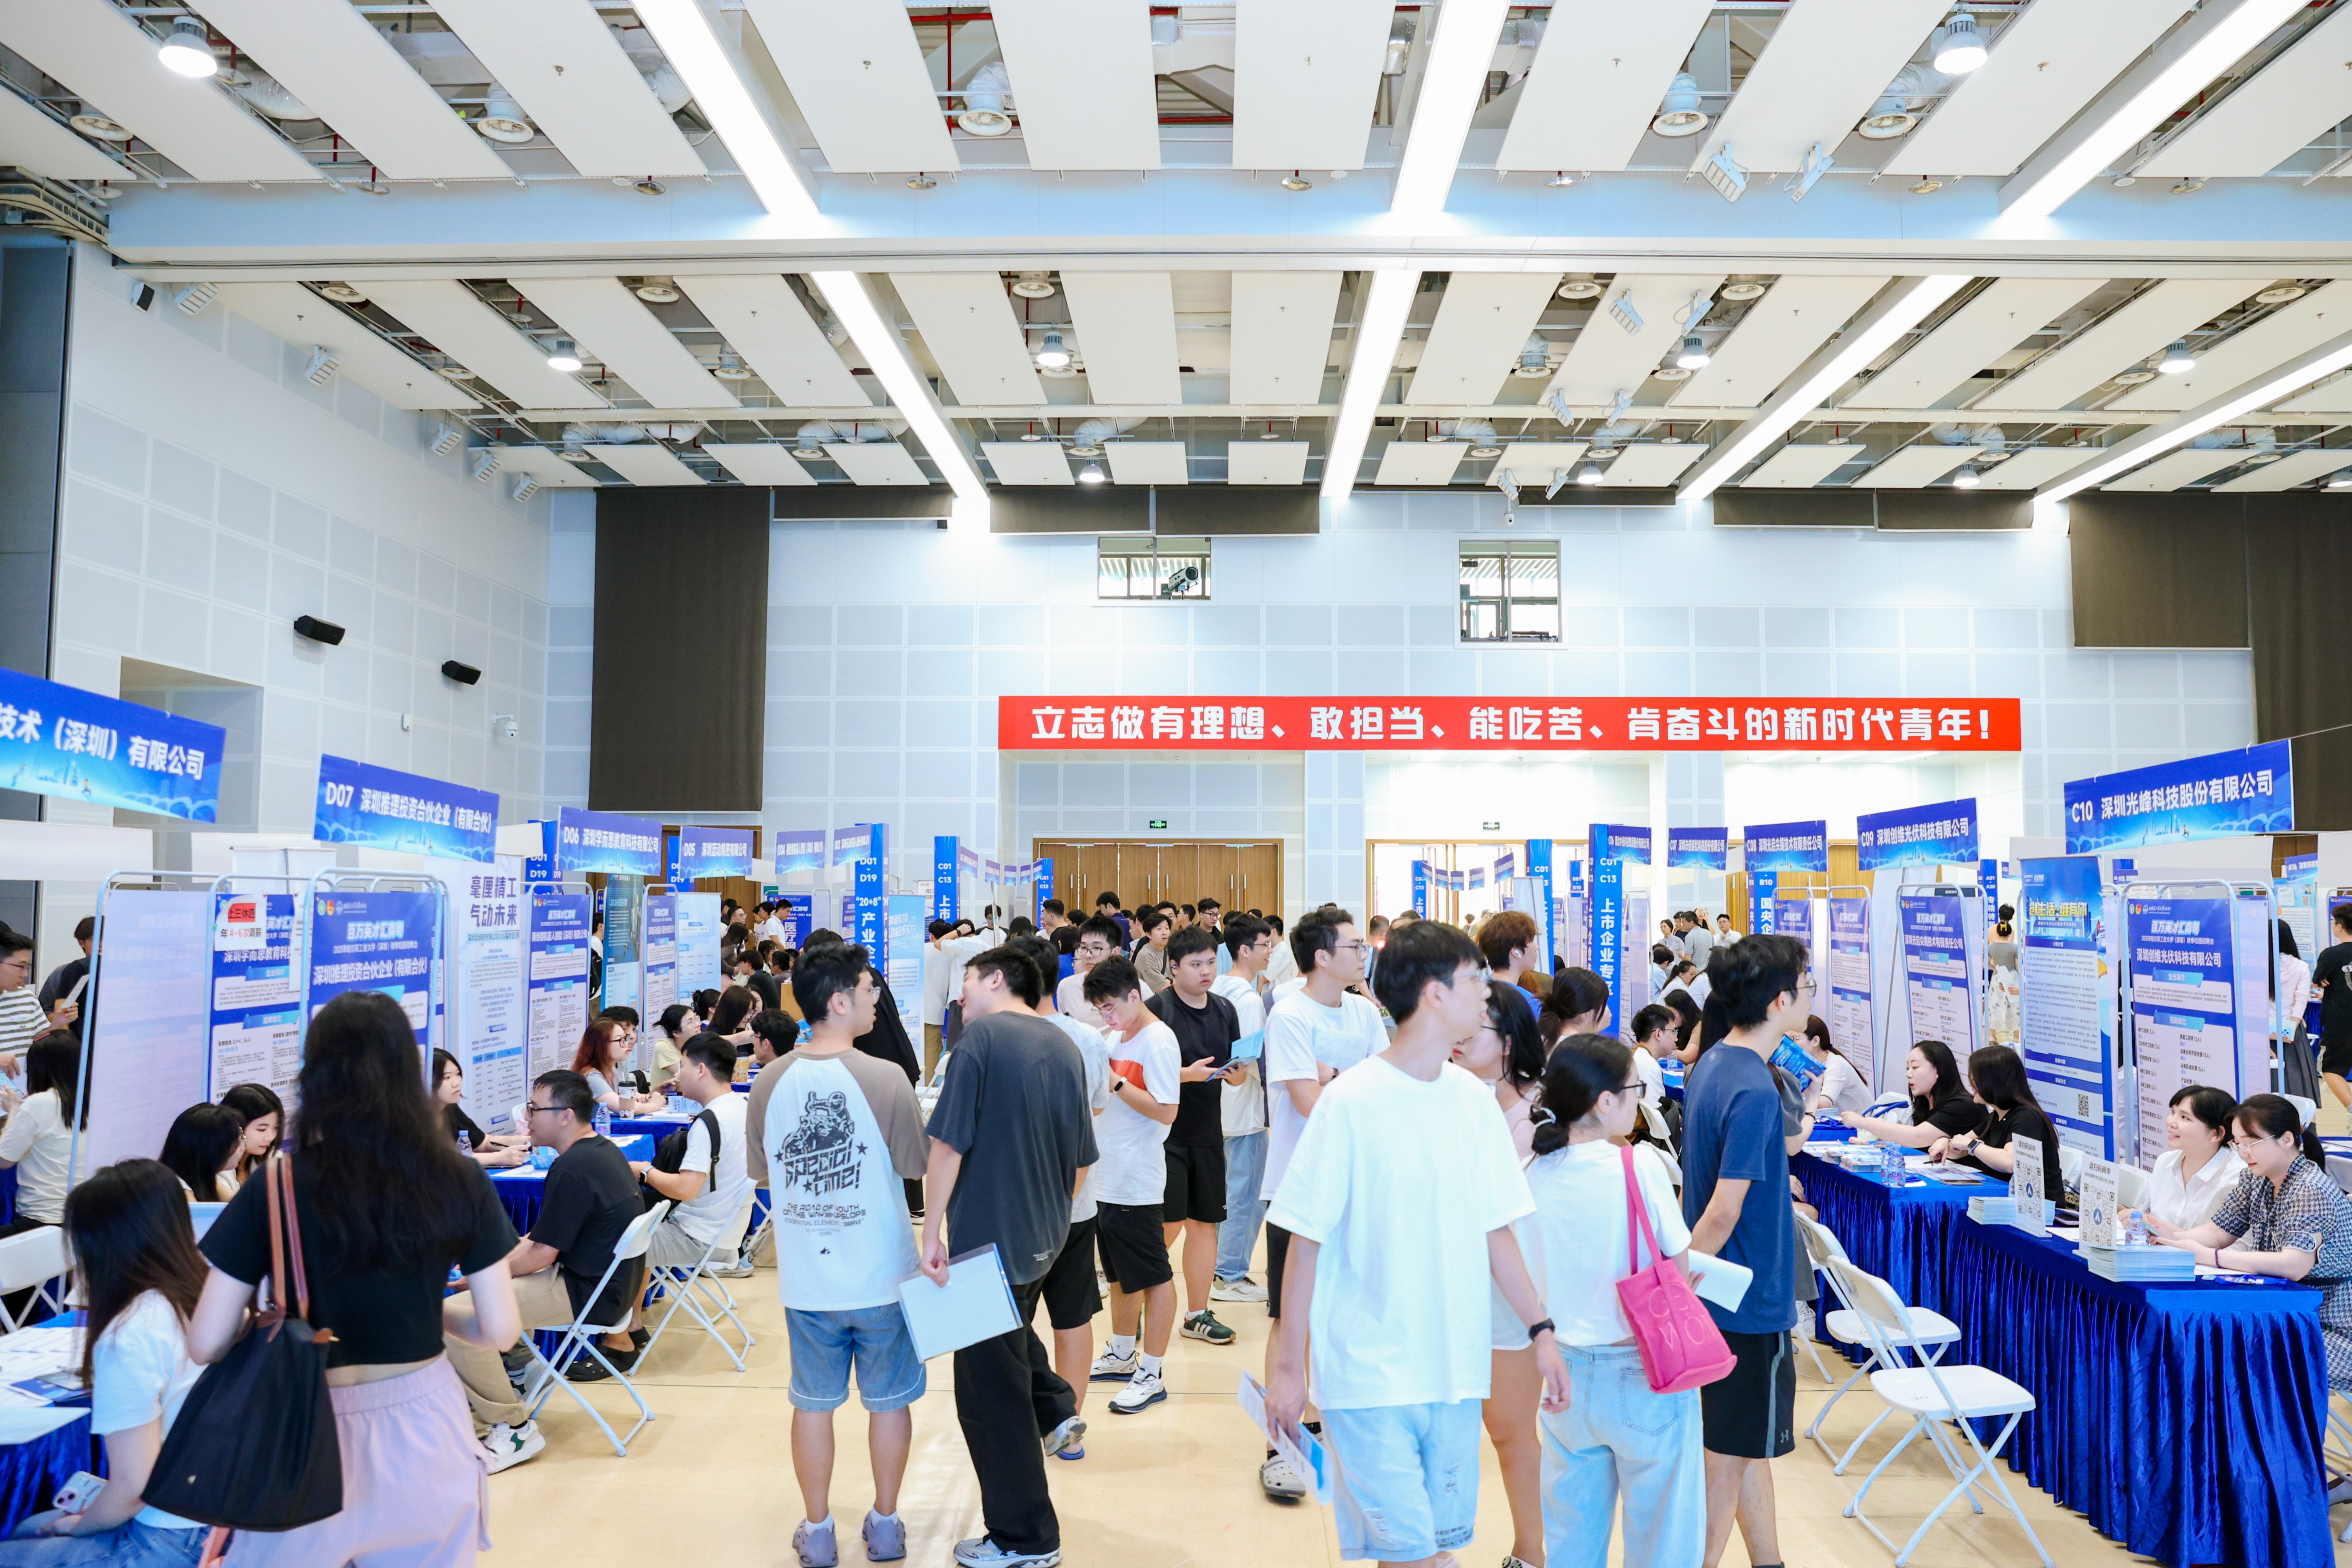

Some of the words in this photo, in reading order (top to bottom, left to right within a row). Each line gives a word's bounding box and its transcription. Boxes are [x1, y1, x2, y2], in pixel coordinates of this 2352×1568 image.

[1031, 705, 1989, 741] 立志做有理想、敢担当、能吃苦、肯奋斗的新时代青年！
[0, 703, 205, 780] 技术（深圳）有限公司
[2071, 801, 2093, 823] C10
[2101, 769, 2273, 820] 深圳光峰科技股份有限公司
[326, 782, 354, 808] D07
[360, 788, 492, 834] 深圳推理投资合伙企业（有限合伙）
[564, 826, 579, 844] D06
[583, 828, 659, 853] 深圳学而思教育科技有限公司
[1861, 830, 1874, 847] C09
[1877, 817, 1969, 847] 深圳创维光伏科技有限公司
[684, 842, 696, 857] D05
[1747, 839, 1756, 852] C08
[1758, 835, 1822, 853] 深圳光启尖端技术有限责任公司
[860, 857, 877, 865] D01
[1600, 857, 1617, 866] C01
[530, 870, 547, 878] D19
[860, 874, 877, 882] D19
[1599, 874, 1617, 883] C13
[471, 875, 517, 899] 毫厘精工
[856, 896, 881, 906] “20+8”
[939, 895, 951, 920] 上市
[2029, 901, 2055, 917] 创生活
[2059, 901, 2087, 918] 维有你
[267, 917, 293, 931] 英才汇
[471, 904, 517, 927] 气动未来
[1760, 898, 1772, 934] 国央企
[2151, 919, 2200, 936] 百万英才汇南粤
[2136, 948, 2221, 968] 深圳创维光伏科技有限公司
[2018, 1140, 2036, 1152] 请扫码网申
[2089, 1162, 2111, 1175] 请扫码网申
[788, 1203, 798, 1211] THE
[836, 1203, 859, 1213] YOUTH
